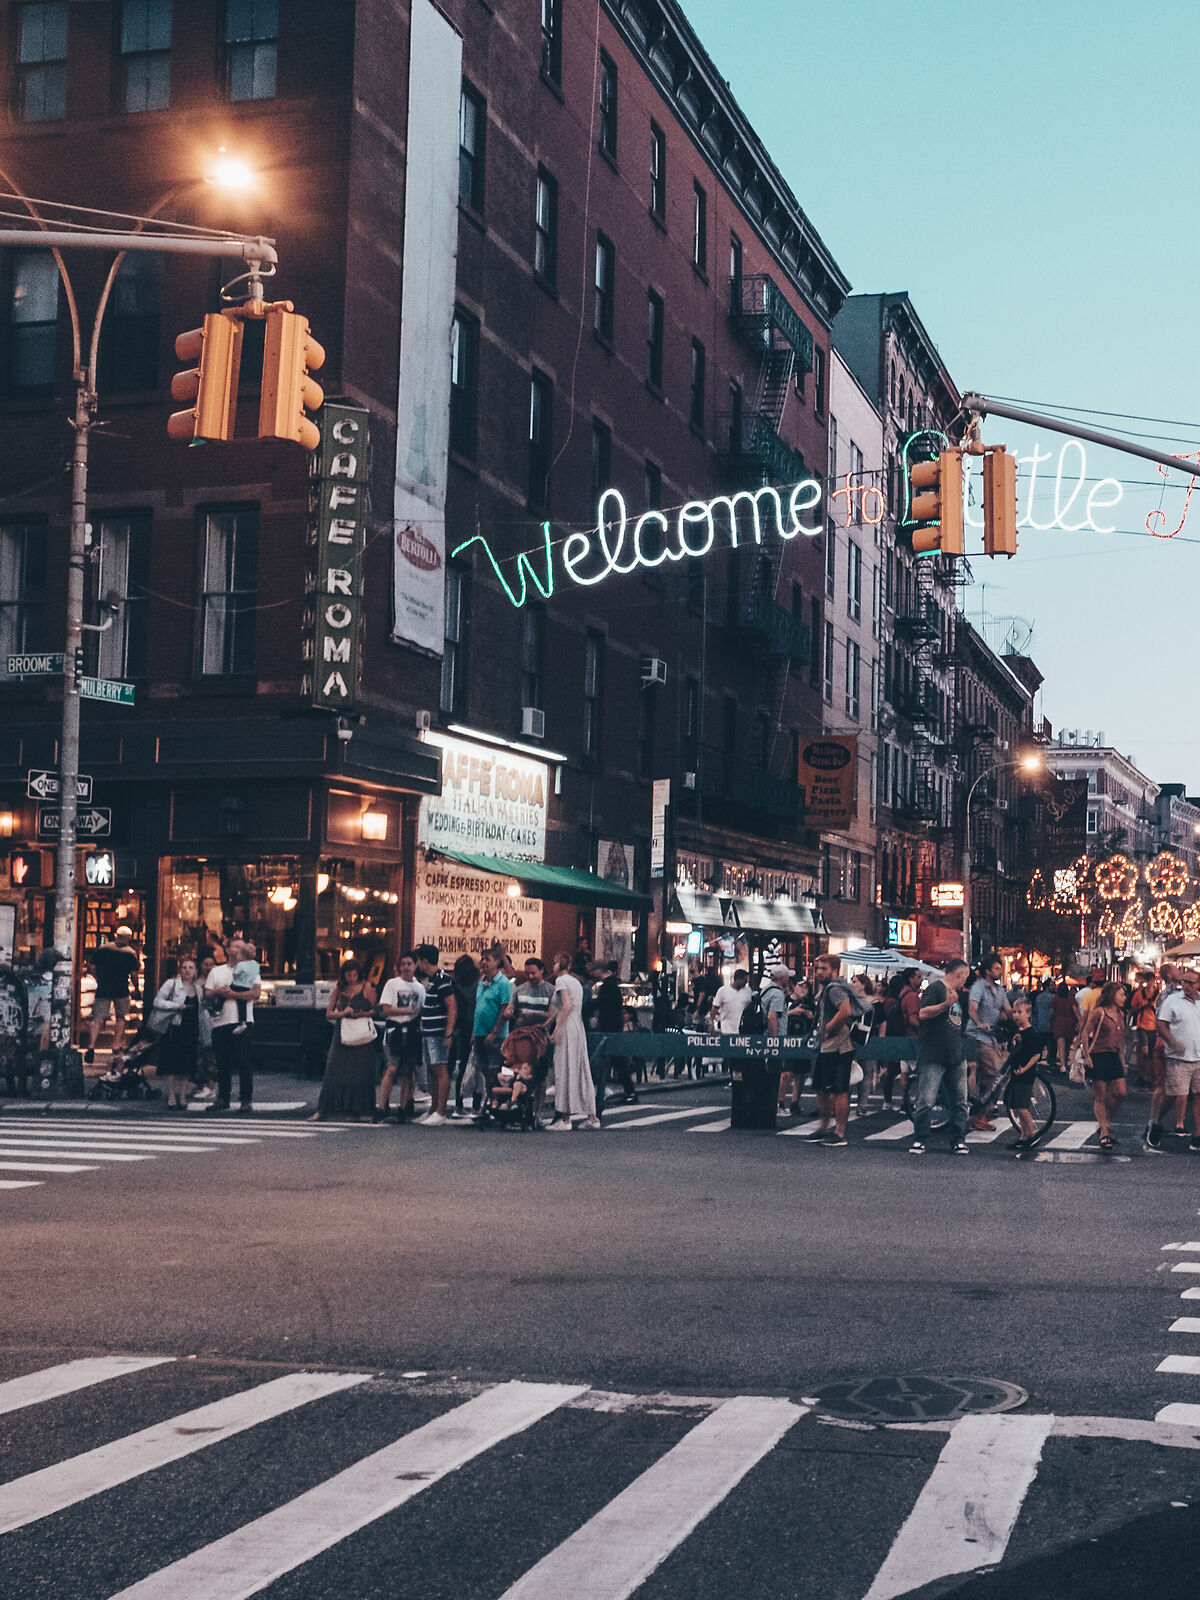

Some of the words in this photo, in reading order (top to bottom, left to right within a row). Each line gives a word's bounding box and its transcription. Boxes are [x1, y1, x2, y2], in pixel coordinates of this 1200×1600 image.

[329, 418, 359, 544] CAFE
[451, 479, 823, 607] Welcome
[832, 472, 885, 527] to
[902, 429, 1123, 557] Litle
[401, 534, 437, 565] BERTOLLI
[323, 567, 353, 697] ROMA
[8, 657, 53, 673] BROOME
[81, 680, 122, 700] MULBERRY
[38, 780, 56, 791] ONE
[495, 764, 544, 809] ROMA
[511, 828, 537, 846] CAKES
[687, 1036, 721, 1047] POLICE
[729, 1037, 751, 1047] LINE
[767, 1038, 779, 1047] DO
[783, 1038, 802, 1048] NOT
[746, 1048, 779, 1056] NYPD
